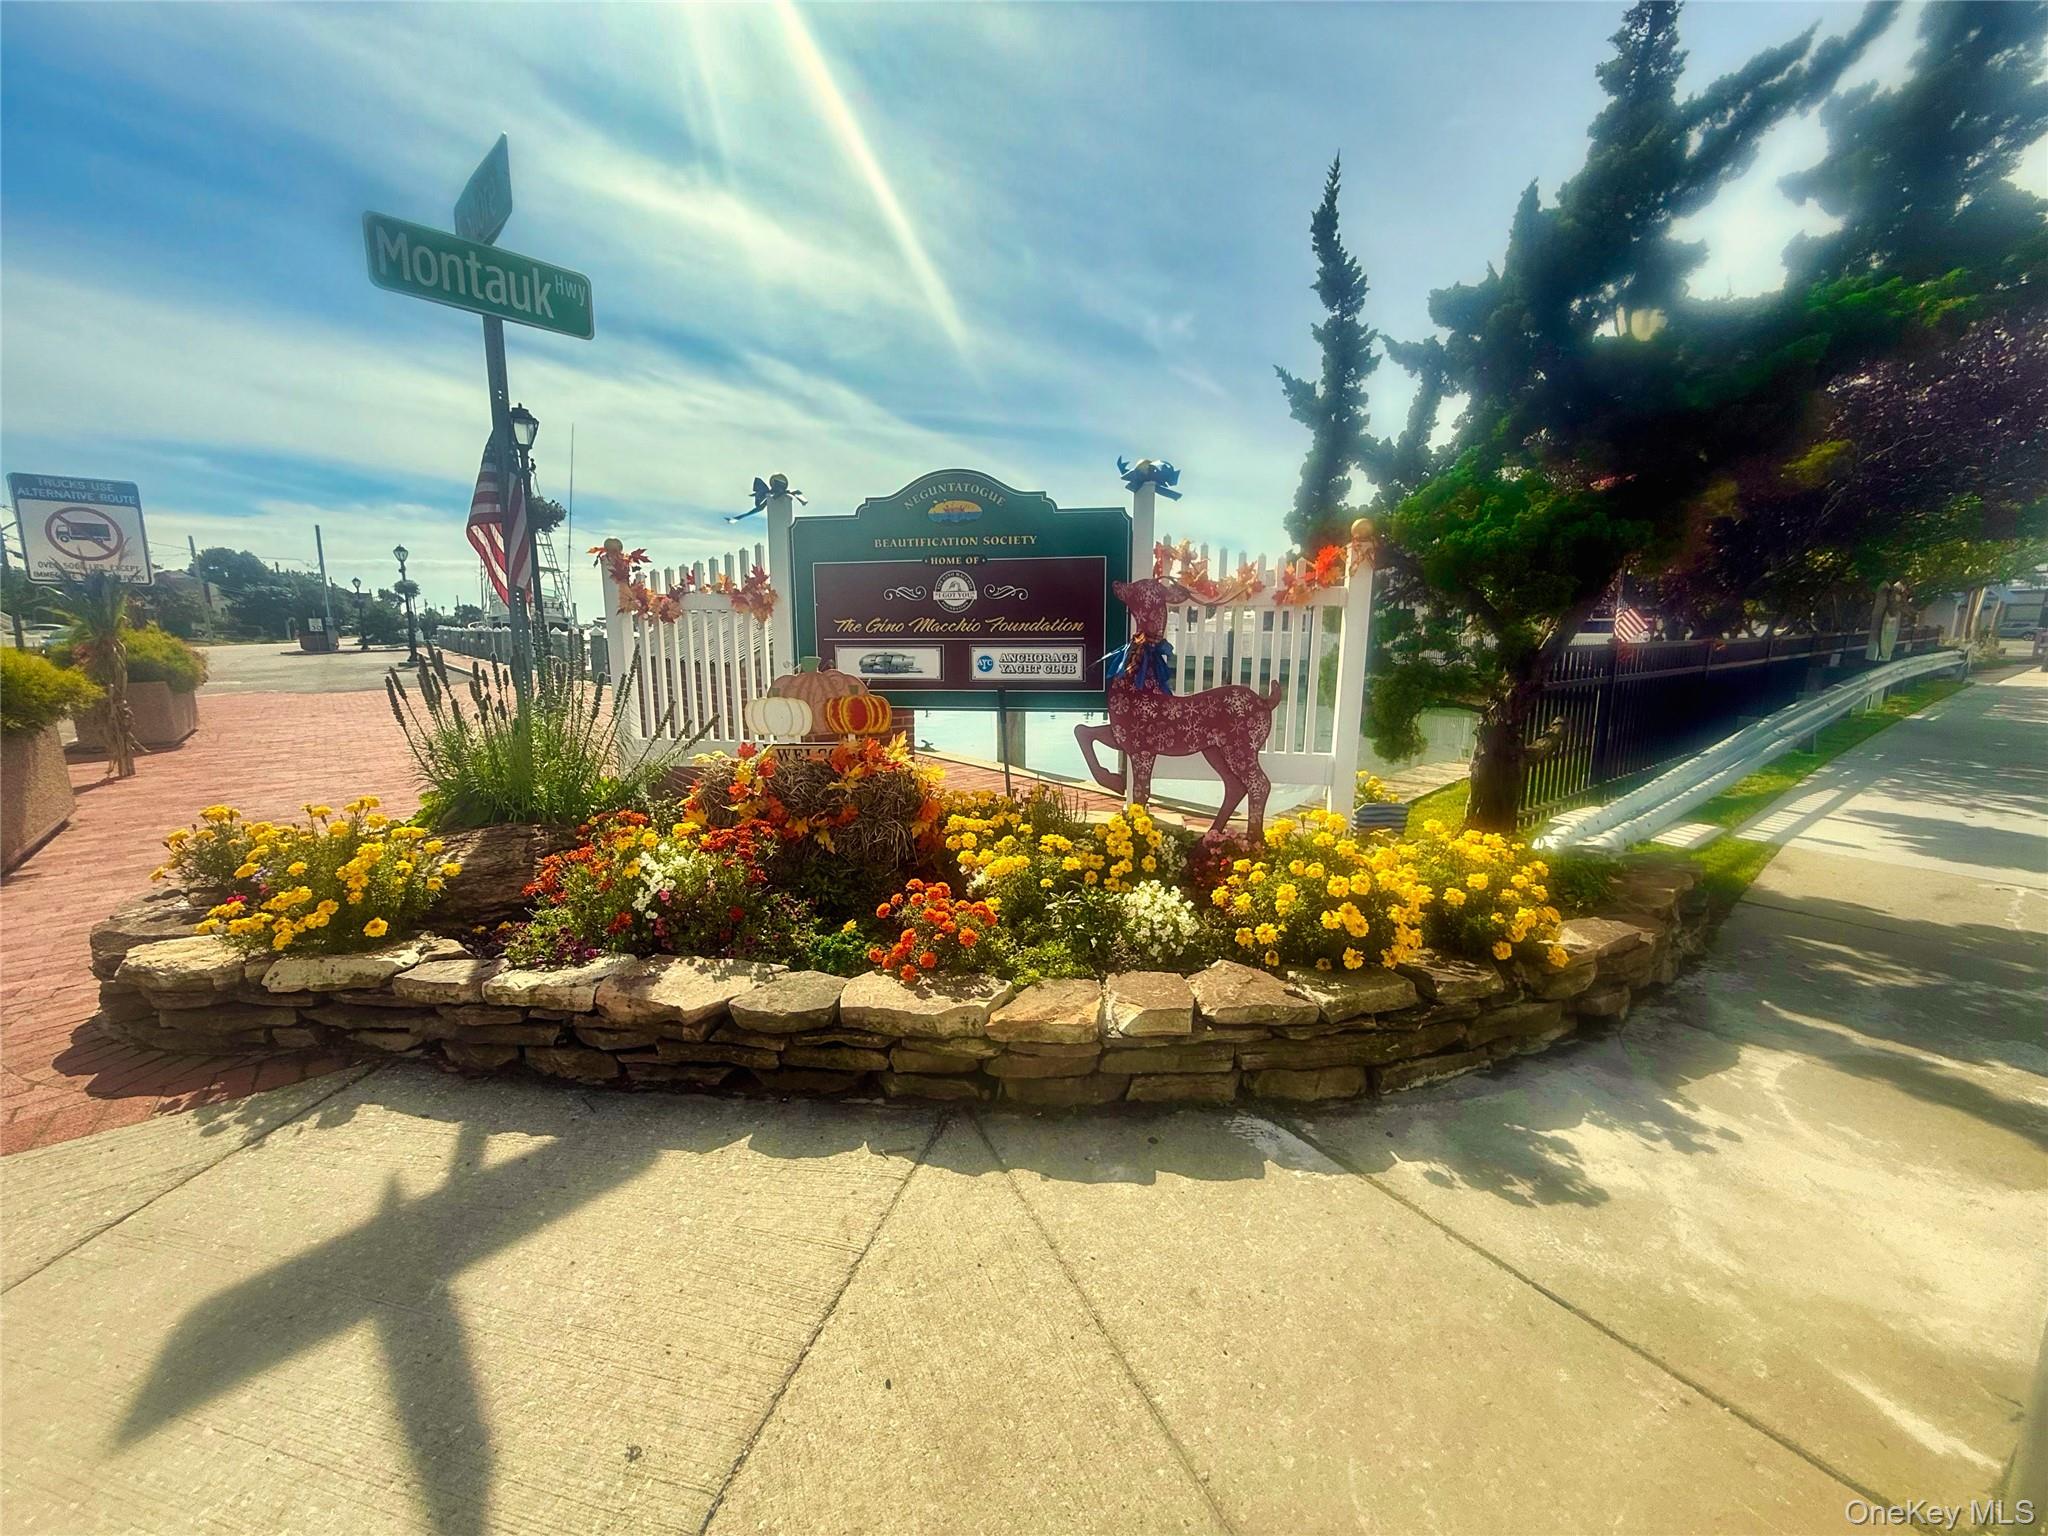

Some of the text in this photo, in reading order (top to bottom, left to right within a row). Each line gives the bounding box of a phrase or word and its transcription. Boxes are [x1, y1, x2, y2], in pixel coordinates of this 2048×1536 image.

[376, 226, 586, 319] Montauk Hwy
[39, 478, 114, 492] TRUCKS USE
[18, 487, 136, 505] ALTERNATIVE ROUTE
[904, 483, 1006, 510] NEGUNTATOGUE
[874, 535, 1037, 548] BEAUTIFICATION SOCIETY
[931, 556, 979, 565] HOME OF
[833, 616, 1084, 633] The Gino Macchio Foundation
[999, 653, 1077, 663] ANCHORAGE
[999, 664, 1077, 674] YACHT CLUB
